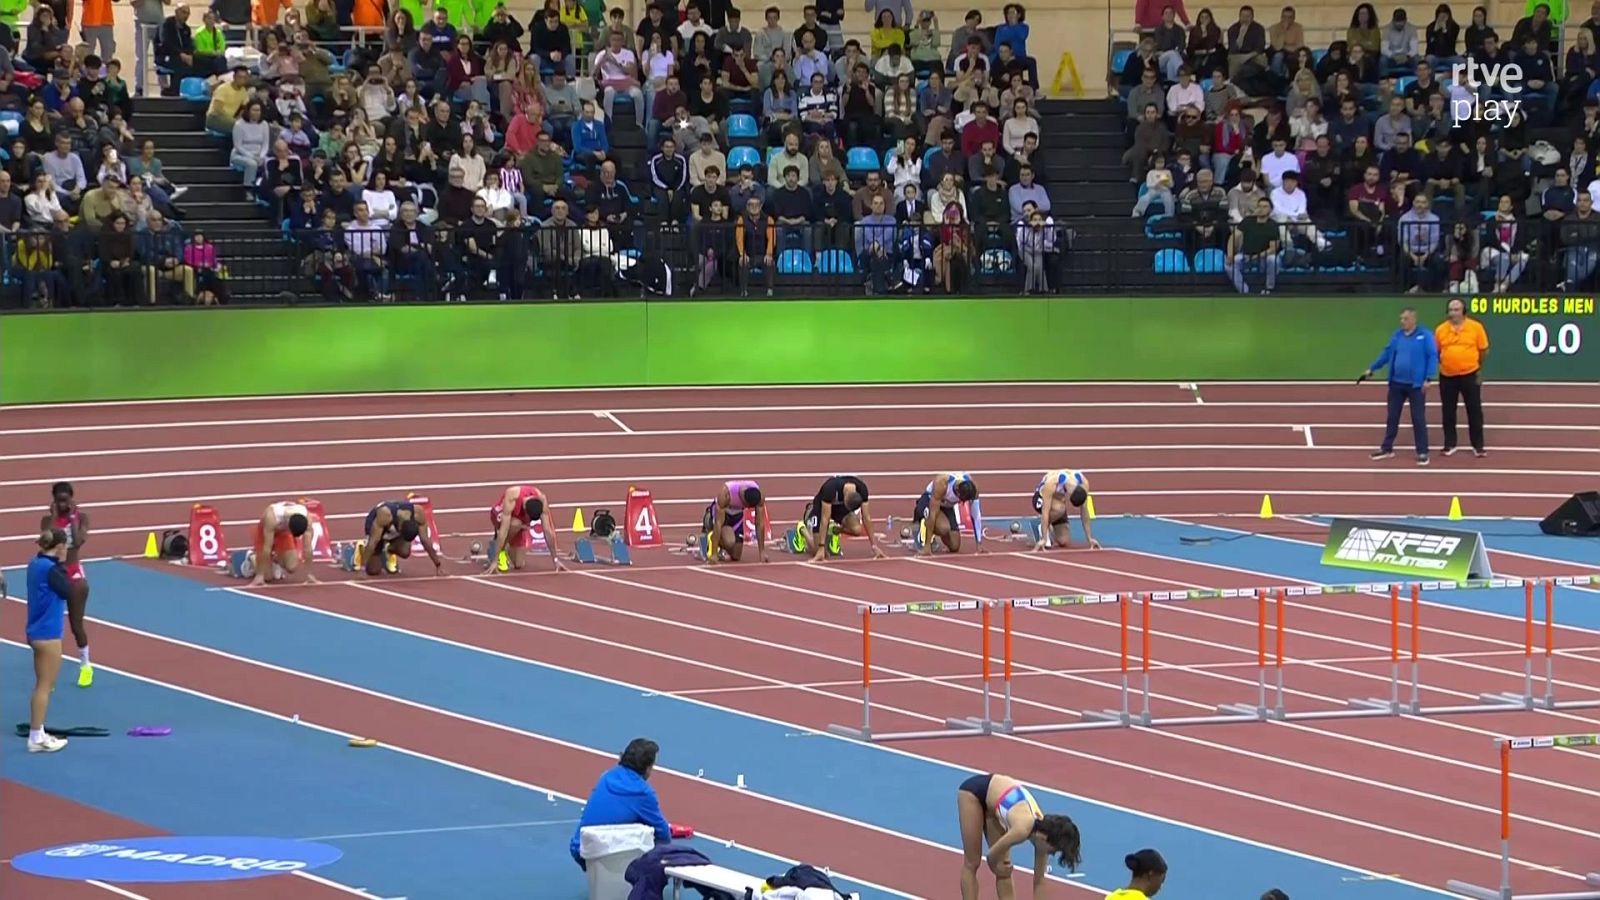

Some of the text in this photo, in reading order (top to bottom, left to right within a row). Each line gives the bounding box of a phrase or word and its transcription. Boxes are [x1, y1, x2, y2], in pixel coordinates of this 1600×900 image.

[1471, 298, 1594, 313] 60 HURDLES MEN
[1525, 323, 1581, 354] 0.0
[635, 507, 653, 535] 4
[199, 524, 219, 555] 8
[1381, 530, 1462, 556] RFEA
[103, 848, 307, 871] MADRID
